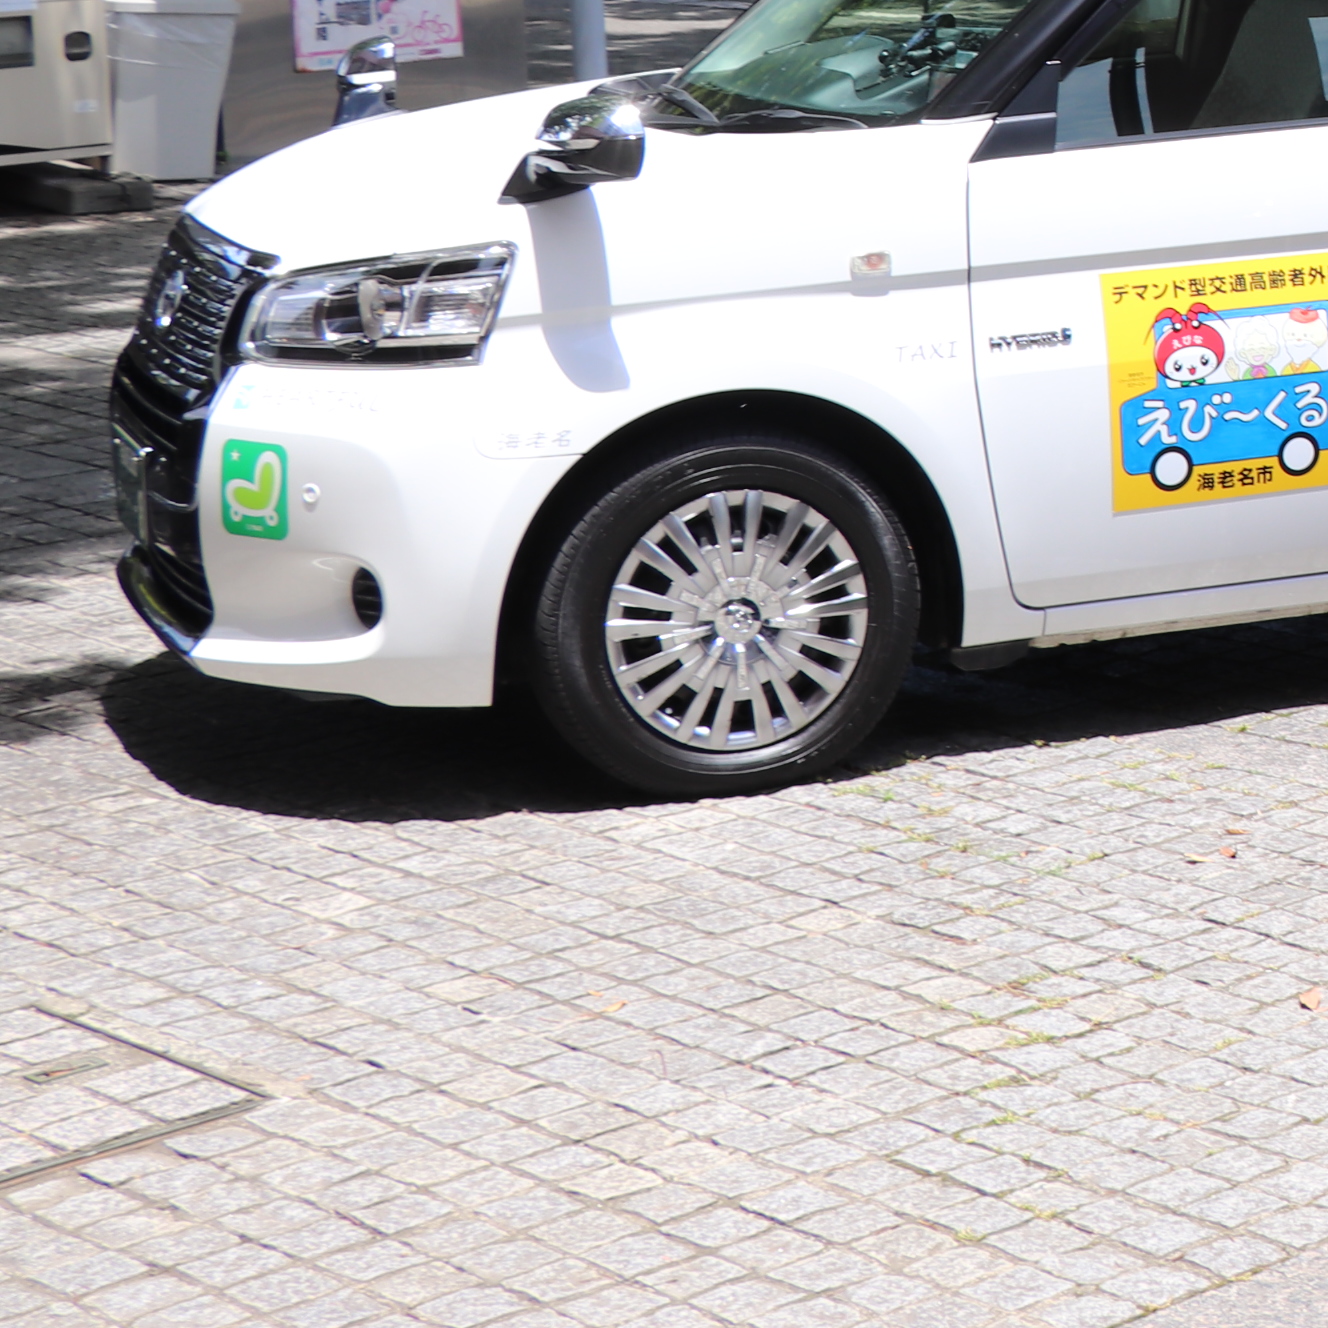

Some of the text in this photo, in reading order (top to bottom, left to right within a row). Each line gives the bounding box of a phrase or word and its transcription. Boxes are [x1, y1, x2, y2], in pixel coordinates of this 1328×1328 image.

[1171, 334, 1204, 351] えびな
[1195, 465, 1275, 493] 海老名市
